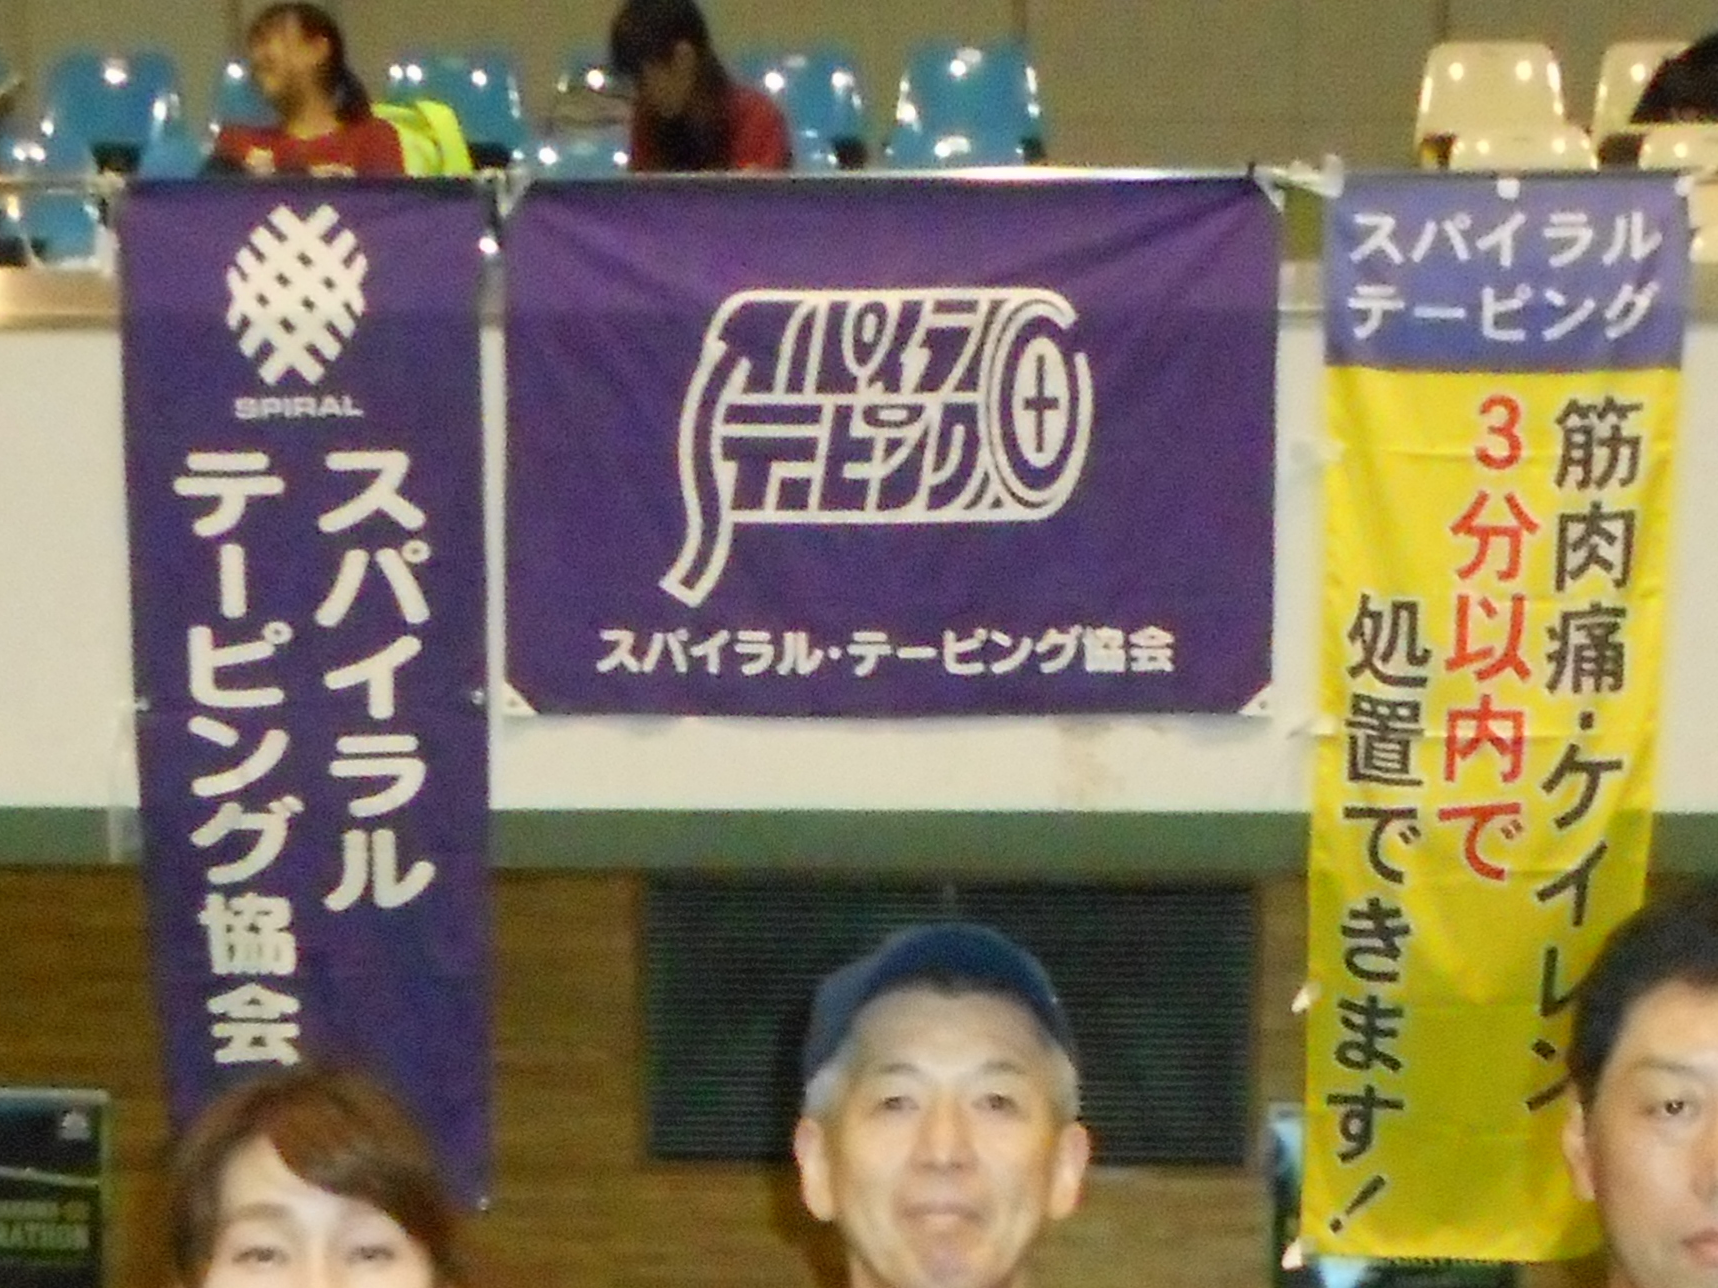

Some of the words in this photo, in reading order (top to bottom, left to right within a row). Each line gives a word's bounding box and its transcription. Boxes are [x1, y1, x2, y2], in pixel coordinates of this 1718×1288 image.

[1347, 283, 1660, 342] テーピング
[1349, 211, 1663, 268] スパイラル
[234, 394, 365, 420] SPIRAL
[173, 449, 305, 1067] テーピング協会
[314, 447, 434, 914] スパイラル
[1438, 395, 1540, 881] 3分以内で
